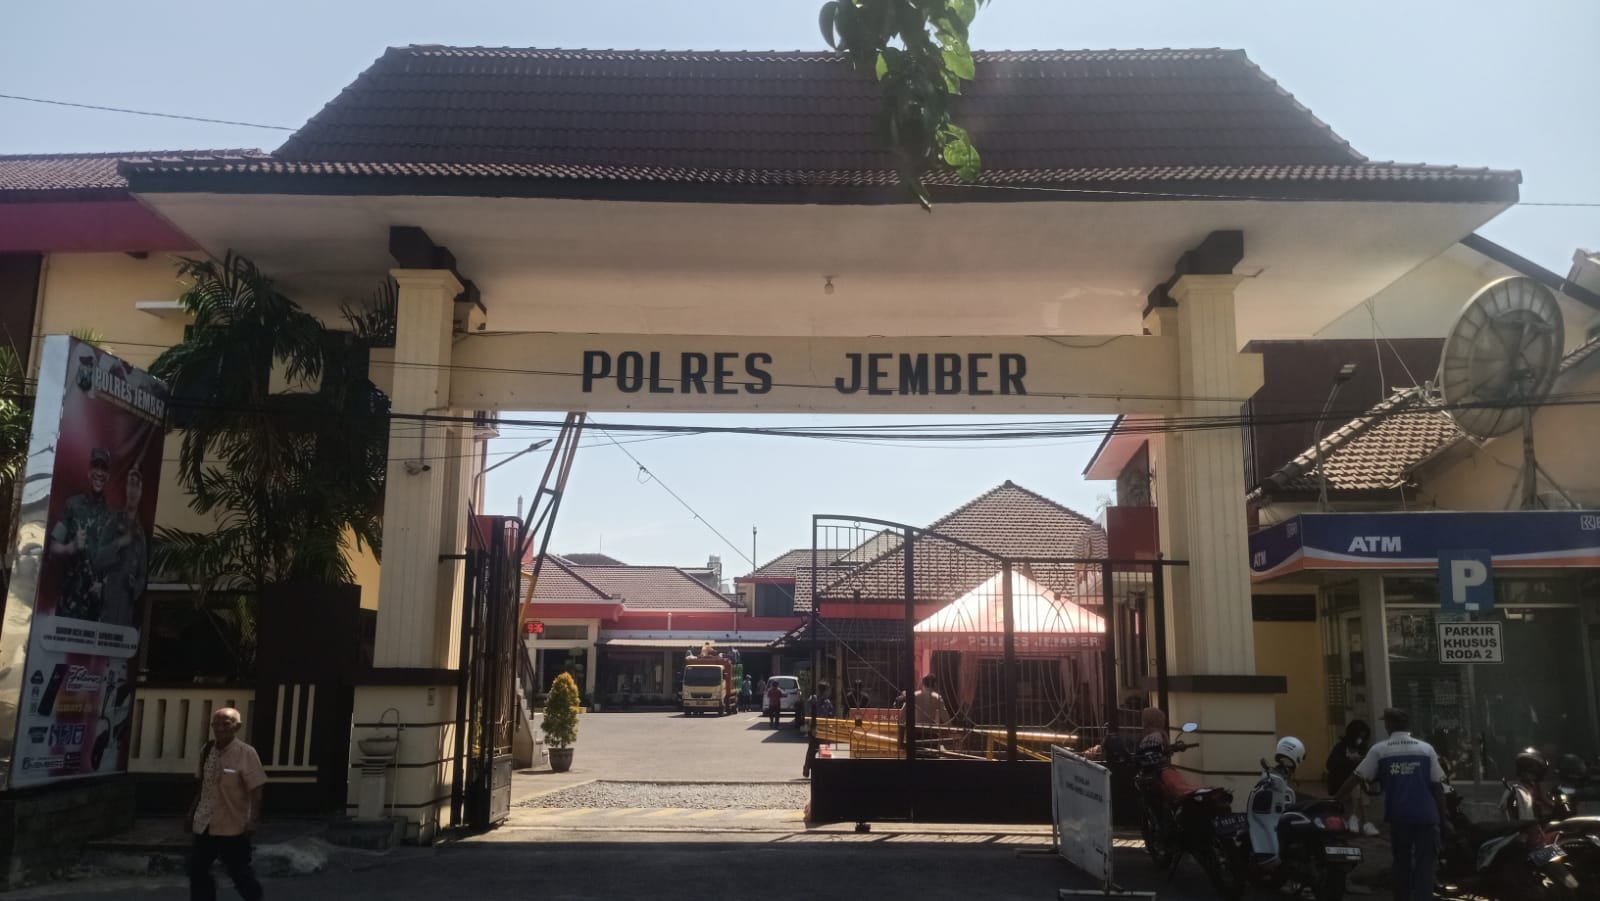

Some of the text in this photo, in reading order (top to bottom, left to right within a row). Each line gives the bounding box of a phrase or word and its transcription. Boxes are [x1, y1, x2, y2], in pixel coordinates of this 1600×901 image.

[582, 350, 1028, 396] POLRES JEMBER
[95, 366, 132, 404] POLRES
[1347, 536, 1402, 553] ATM
[1253, 549, 1268, 568] ATM
[1450, 559, 1488, 604] P
[1444, 625, 1495, 637] PARKIR
[1033, 635, 1100, 648] JEMBER
[1442, 637, 1498, 649] KHUSUS
[1446, 649, 1493, 660] RODA 2
